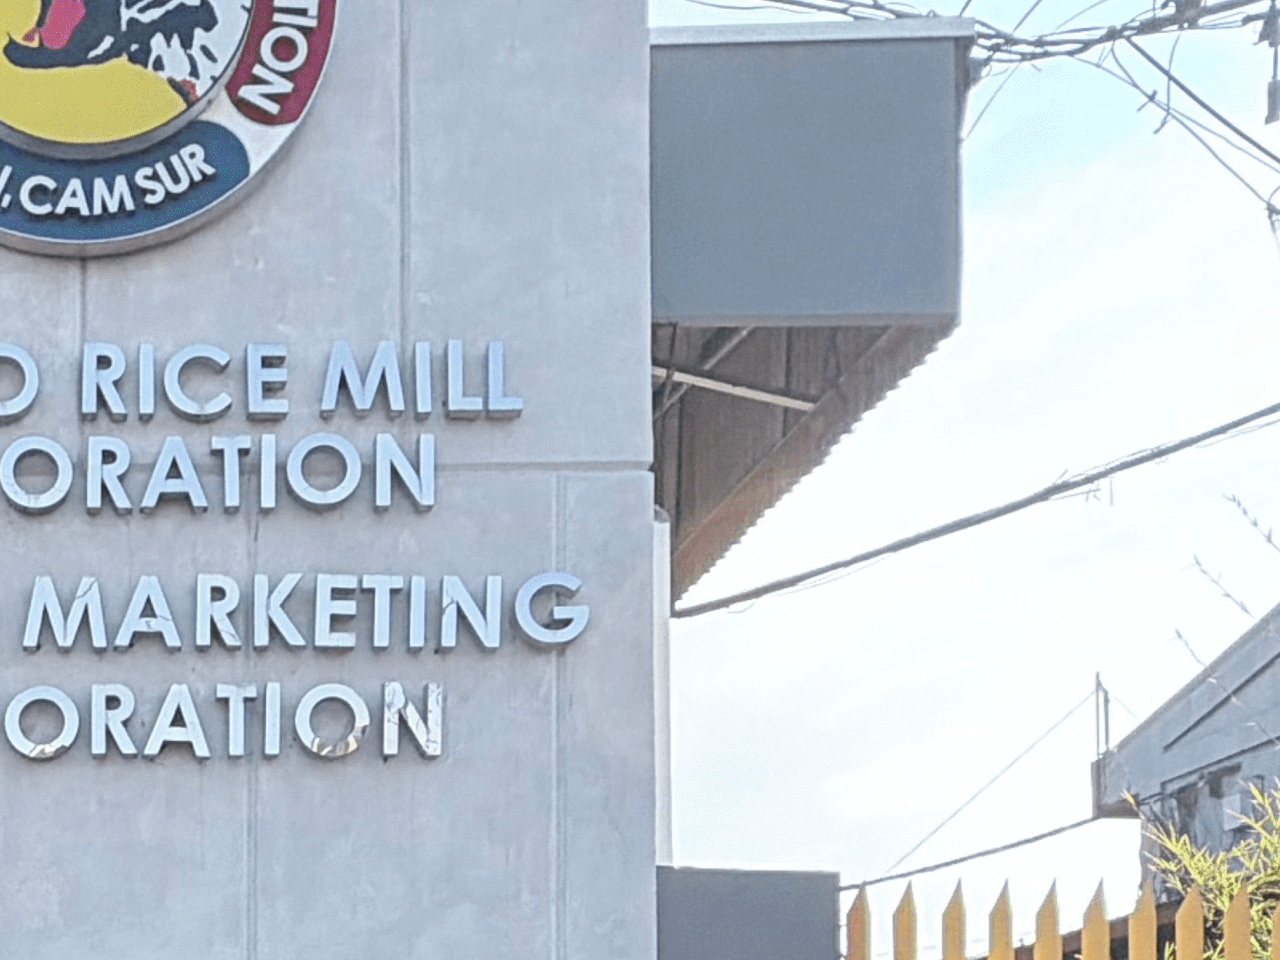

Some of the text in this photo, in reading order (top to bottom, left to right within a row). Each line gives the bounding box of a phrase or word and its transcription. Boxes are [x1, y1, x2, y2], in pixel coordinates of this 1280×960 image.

[19, 174, 136, 217] CAM
[134, 143, 217, 205] SUR
[81, 340, 290, 420] RICE
[319, 339, 524, 418] MILL
[22, 572, 591, 650] MARKETING
